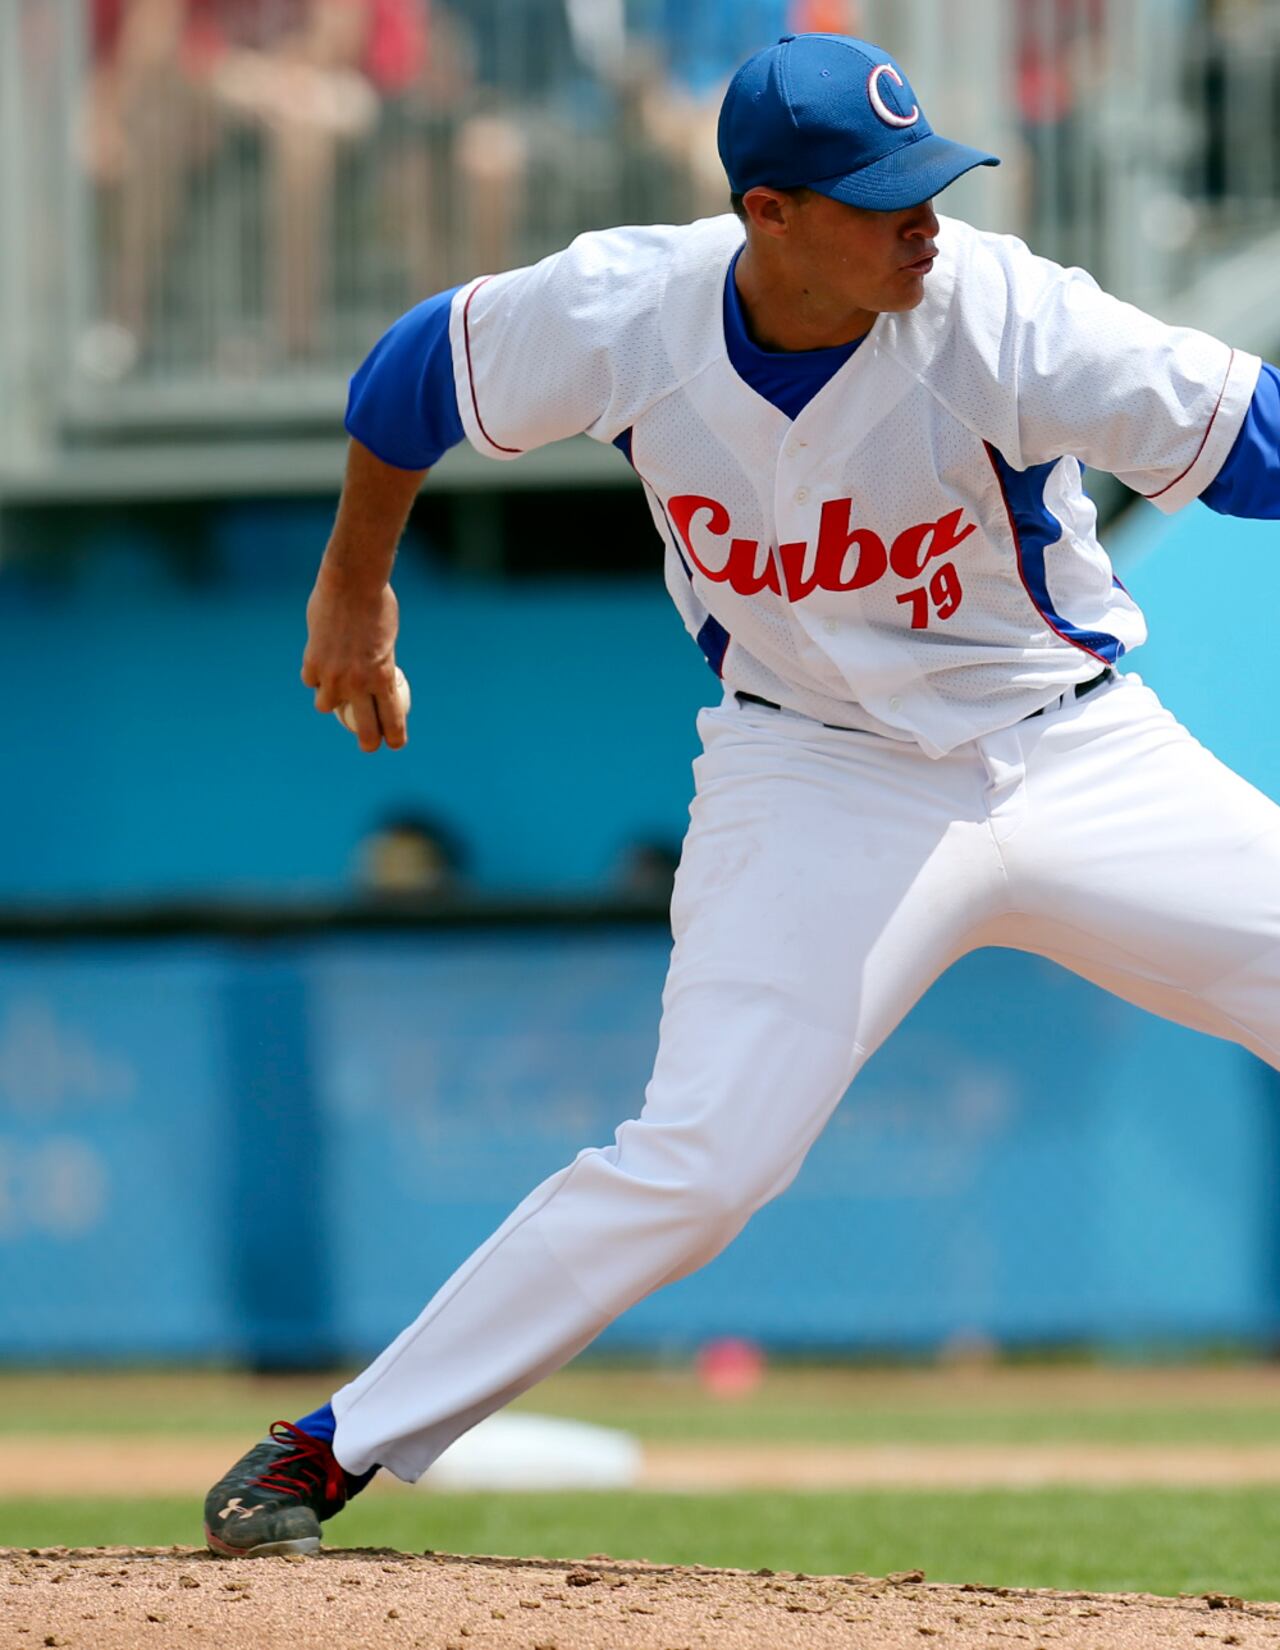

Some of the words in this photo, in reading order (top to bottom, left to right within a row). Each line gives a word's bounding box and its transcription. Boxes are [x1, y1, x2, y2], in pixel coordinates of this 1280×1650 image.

[867, 63, 919, 128] C
[667, 495, 977, 603] Cuba
[896, 562, 962, 628] 79
